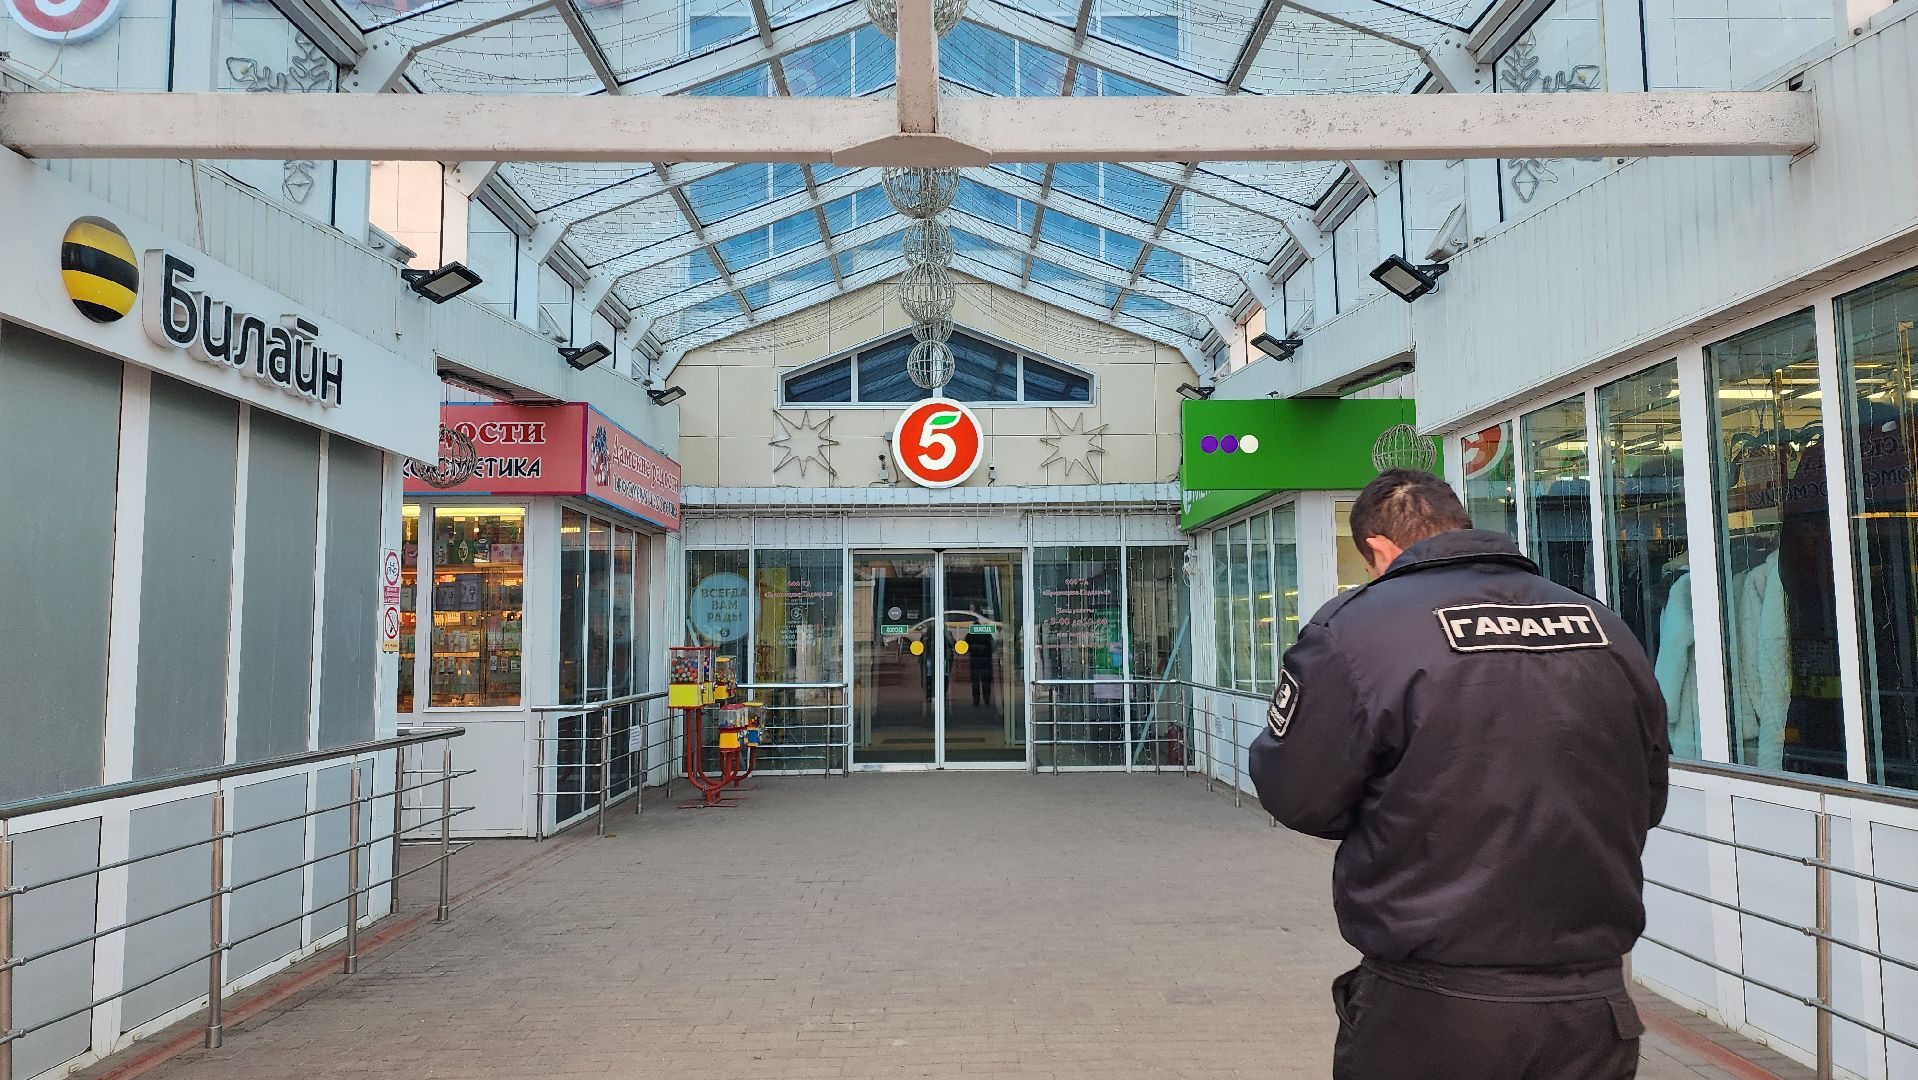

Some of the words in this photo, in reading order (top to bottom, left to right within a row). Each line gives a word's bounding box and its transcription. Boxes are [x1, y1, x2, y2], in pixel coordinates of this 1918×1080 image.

[161, 253, 343, 405] Билайн
[918, 411, 962, 470] 5
[701, 588, 747, 598] ВСЕГДА
[712, 601, 738, 610] ВАМ
[707, 612, 742, 623] РАДЫ
[1450, 615, 1591, 639] ГАРАНТ
